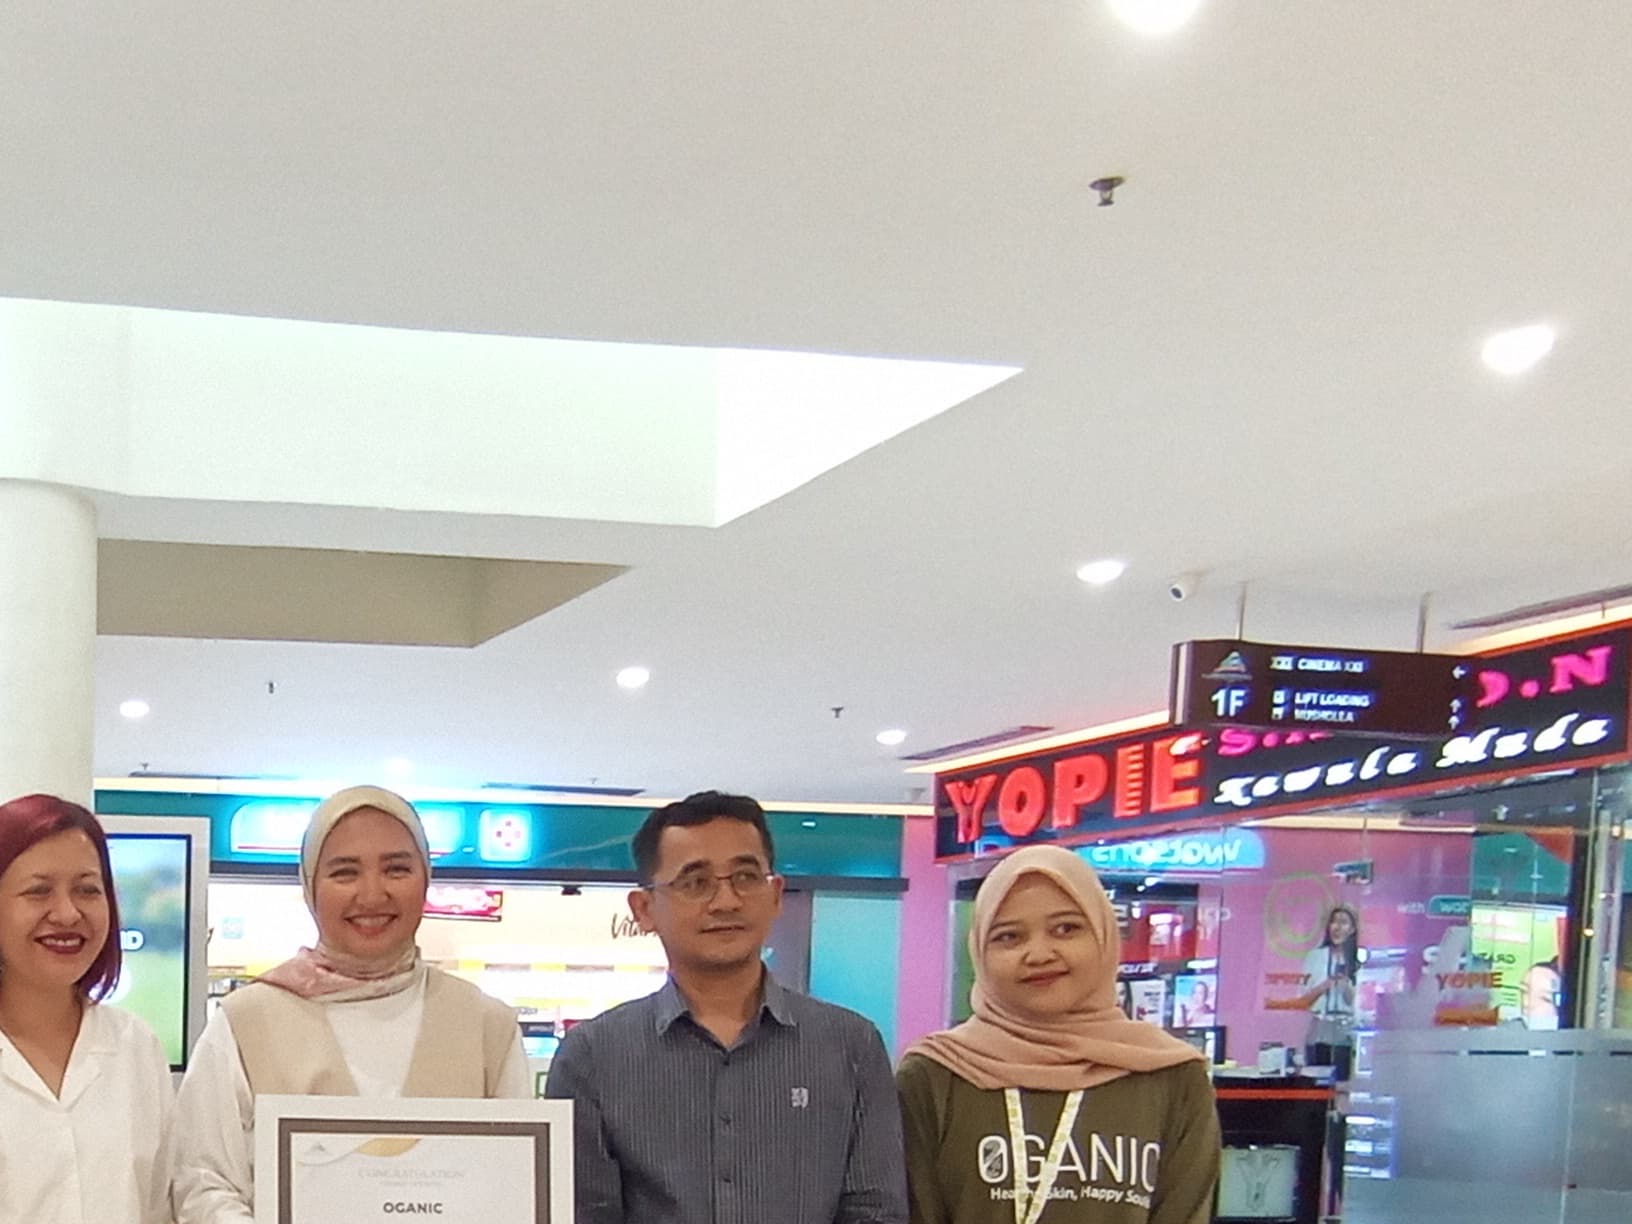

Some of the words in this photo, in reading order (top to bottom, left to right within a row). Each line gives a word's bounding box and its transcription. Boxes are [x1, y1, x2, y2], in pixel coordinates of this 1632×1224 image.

[1297, 658, 1342, 672] CINEMA
[1211, 688, 1247, 717] 1F
[1294, 691, 1319, 706] LIFT
[1320, 692, 1369, 707] LOADING
[944, 731, 1202, 844] YOPIE
[1080, 1185, 1123, 1203] Happy
[382, 1202, 444, 1215] OGANIC
